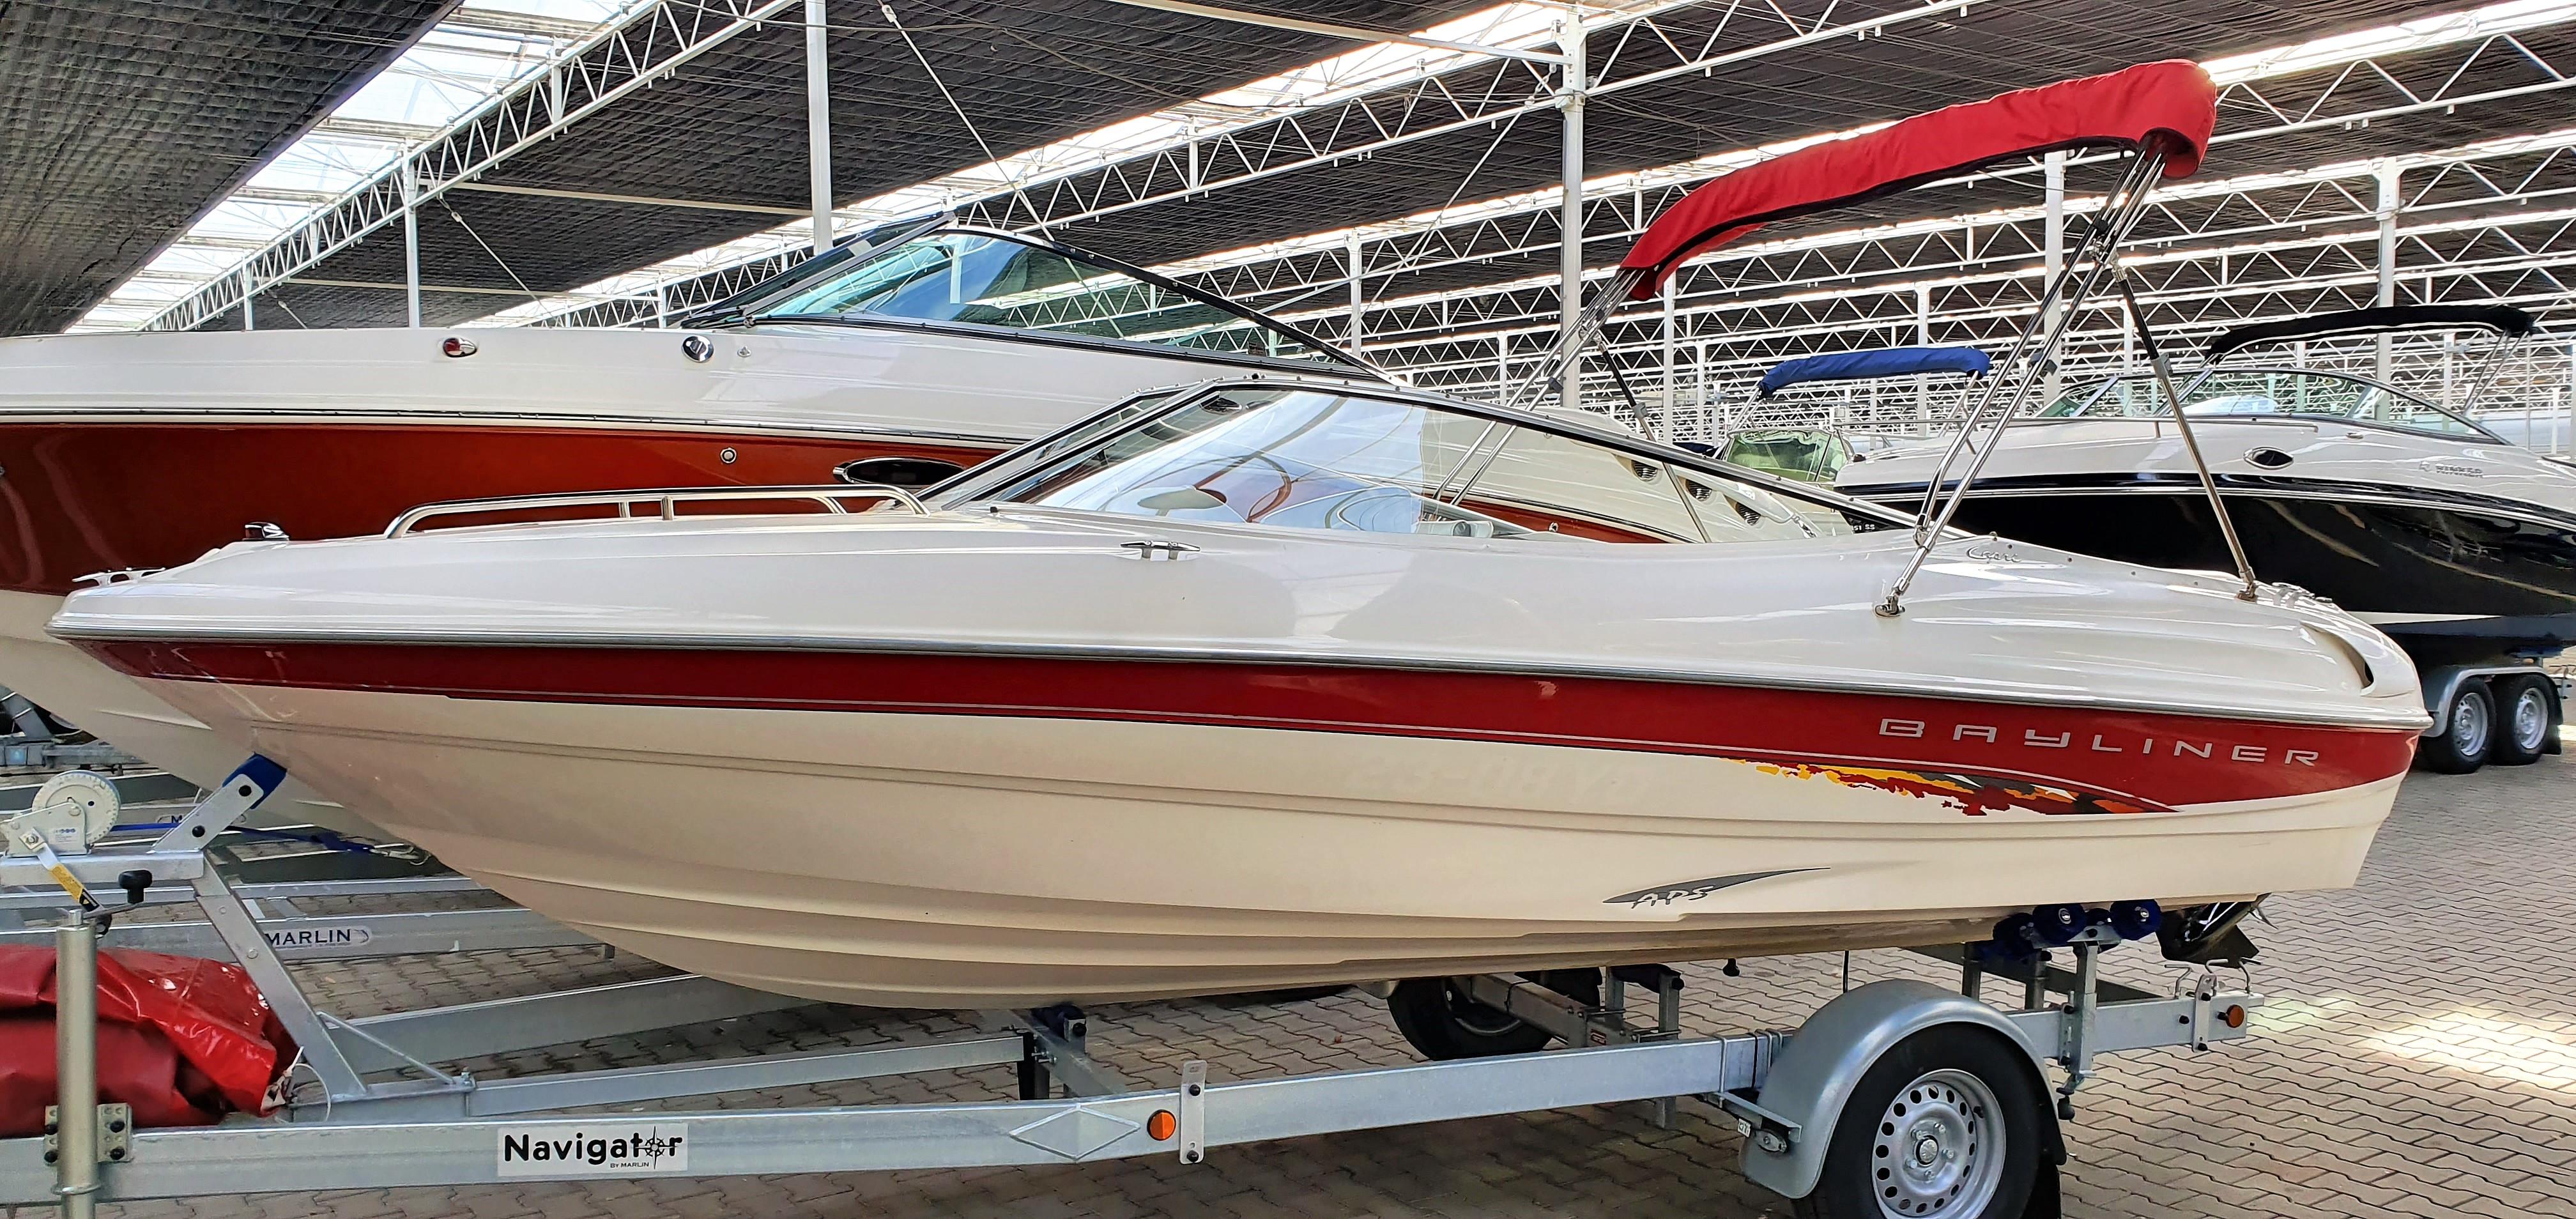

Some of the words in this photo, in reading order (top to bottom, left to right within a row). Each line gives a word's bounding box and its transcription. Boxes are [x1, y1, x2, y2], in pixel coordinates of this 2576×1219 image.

[1966, 546, 2022, 564] Capri
[1879, 718, 2319, 766] BAYLINER
[1631, 885, 1714, 909] APS
[264, 928, 351, 946] MARLIN
